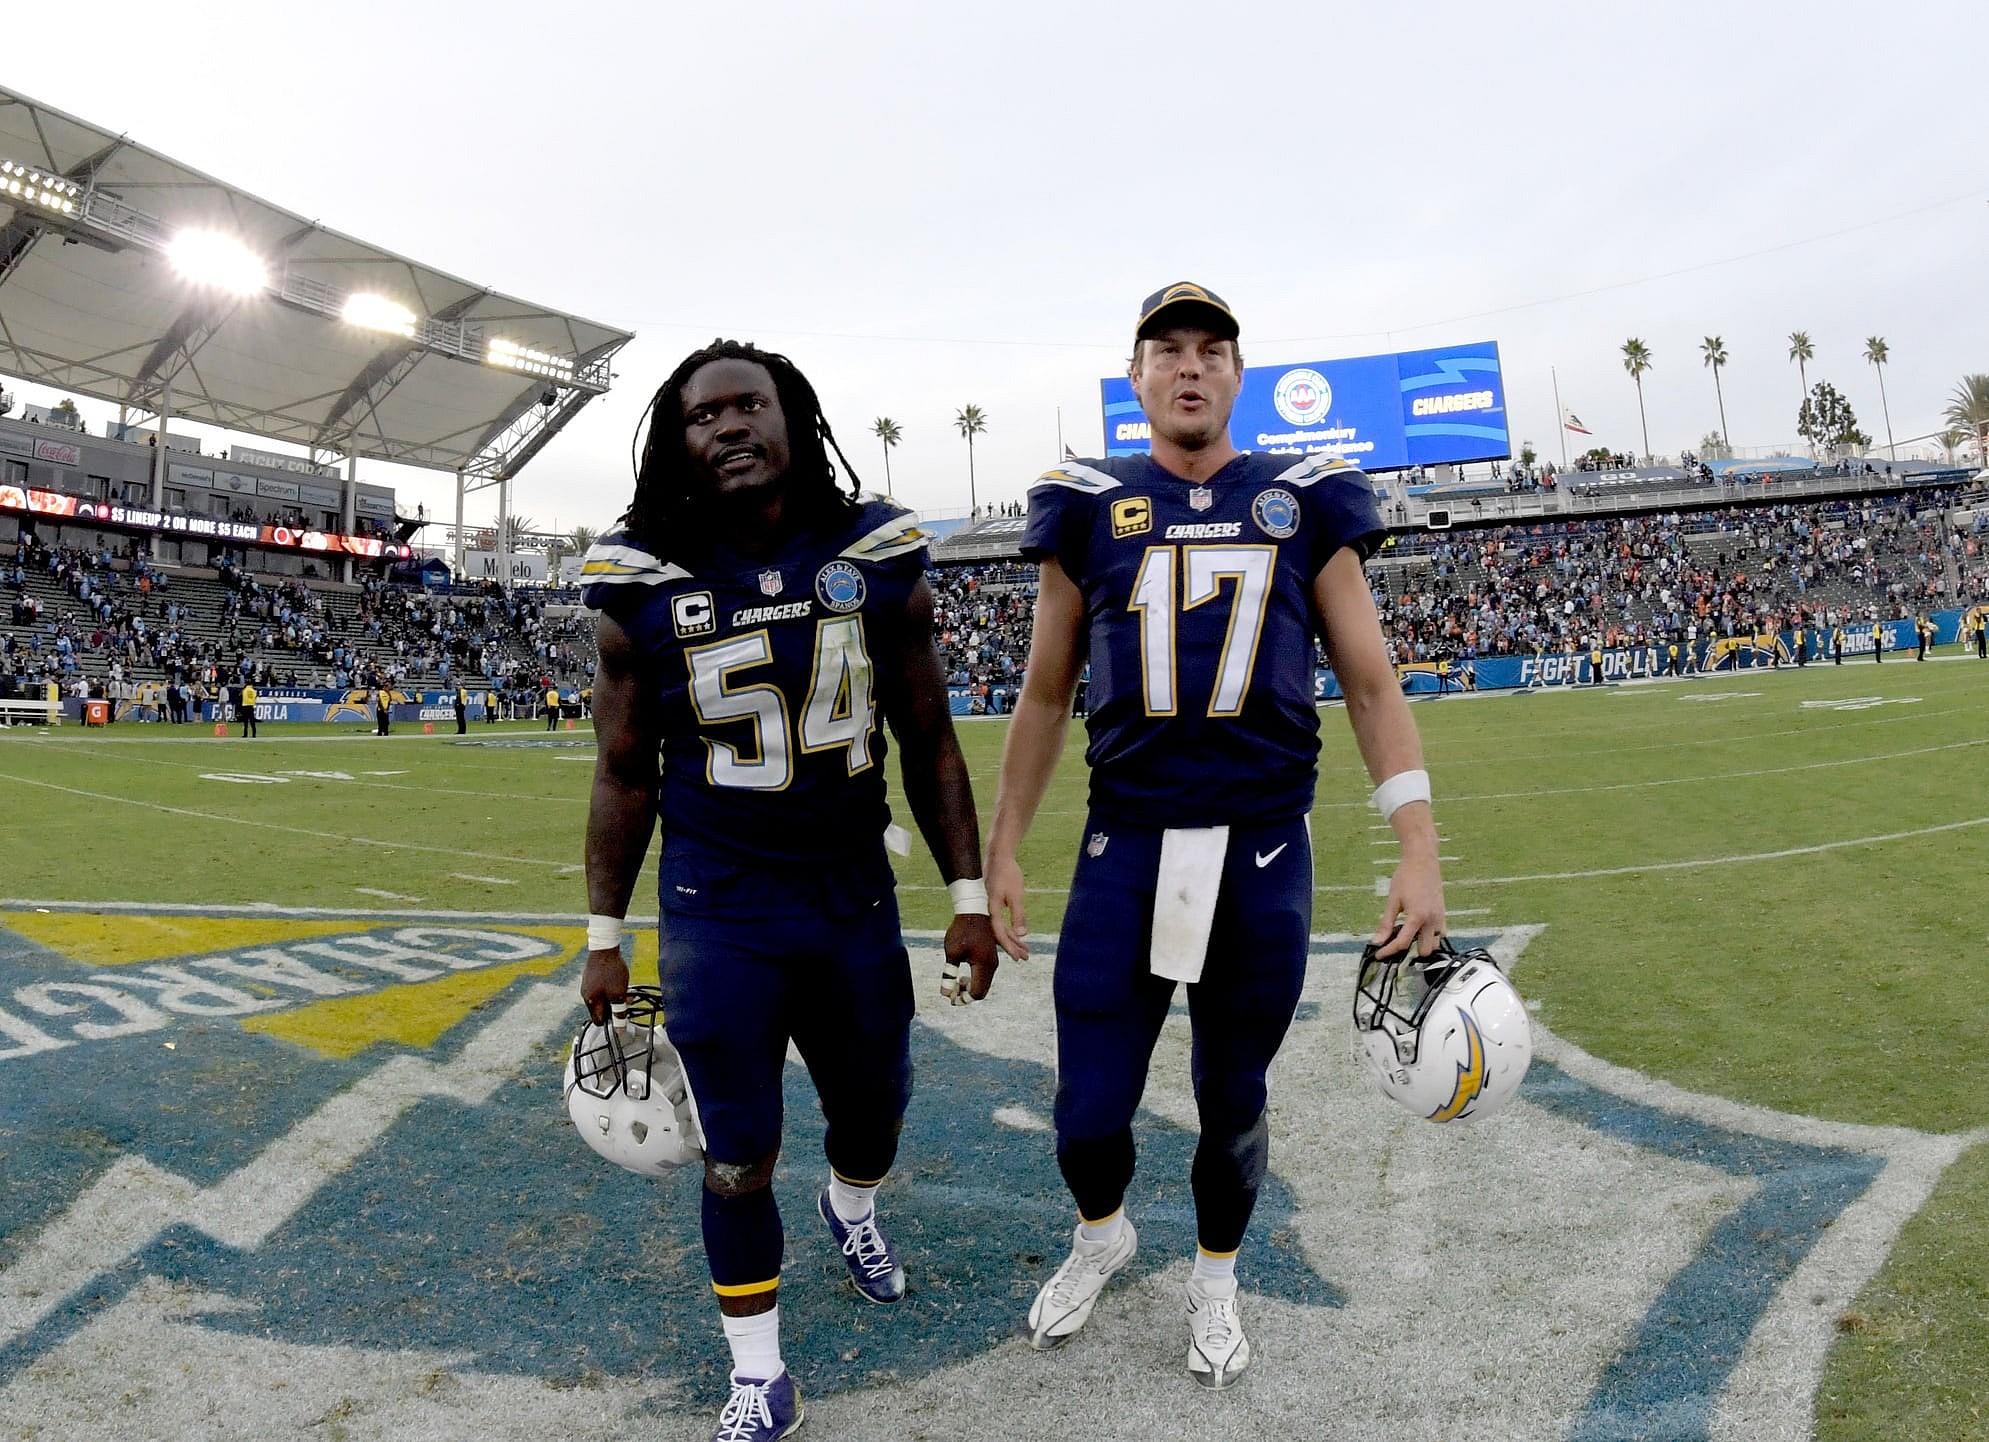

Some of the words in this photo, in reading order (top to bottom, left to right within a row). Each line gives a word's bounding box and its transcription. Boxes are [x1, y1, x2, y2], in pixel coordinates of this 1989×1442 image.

[1413, 391, 1494, 416] CHARGERS
[1116, 422, 1152, 441] CHA
[260, 482, 296, 496] Spectrum
[126, 510, 162, 527] LINEUP
[163, 515, 170, 528] 2
[172, 516, 187, 530] OR
[189, 519, 216, 534] MORE
[232, 524, 258, 539] EACH
[1114, 500, 1148, 528] C
[1165, 522, 1242, 539] CHARGERS
[675, 595, 711, 627] C
[732, 600, 813, 627] CHARGERS
[1127, 544, 1278, 717] 17
[91, 706, 102, 718] G
[273, 704, 288, 720] LA
[684, 612, 876, 792] 54
